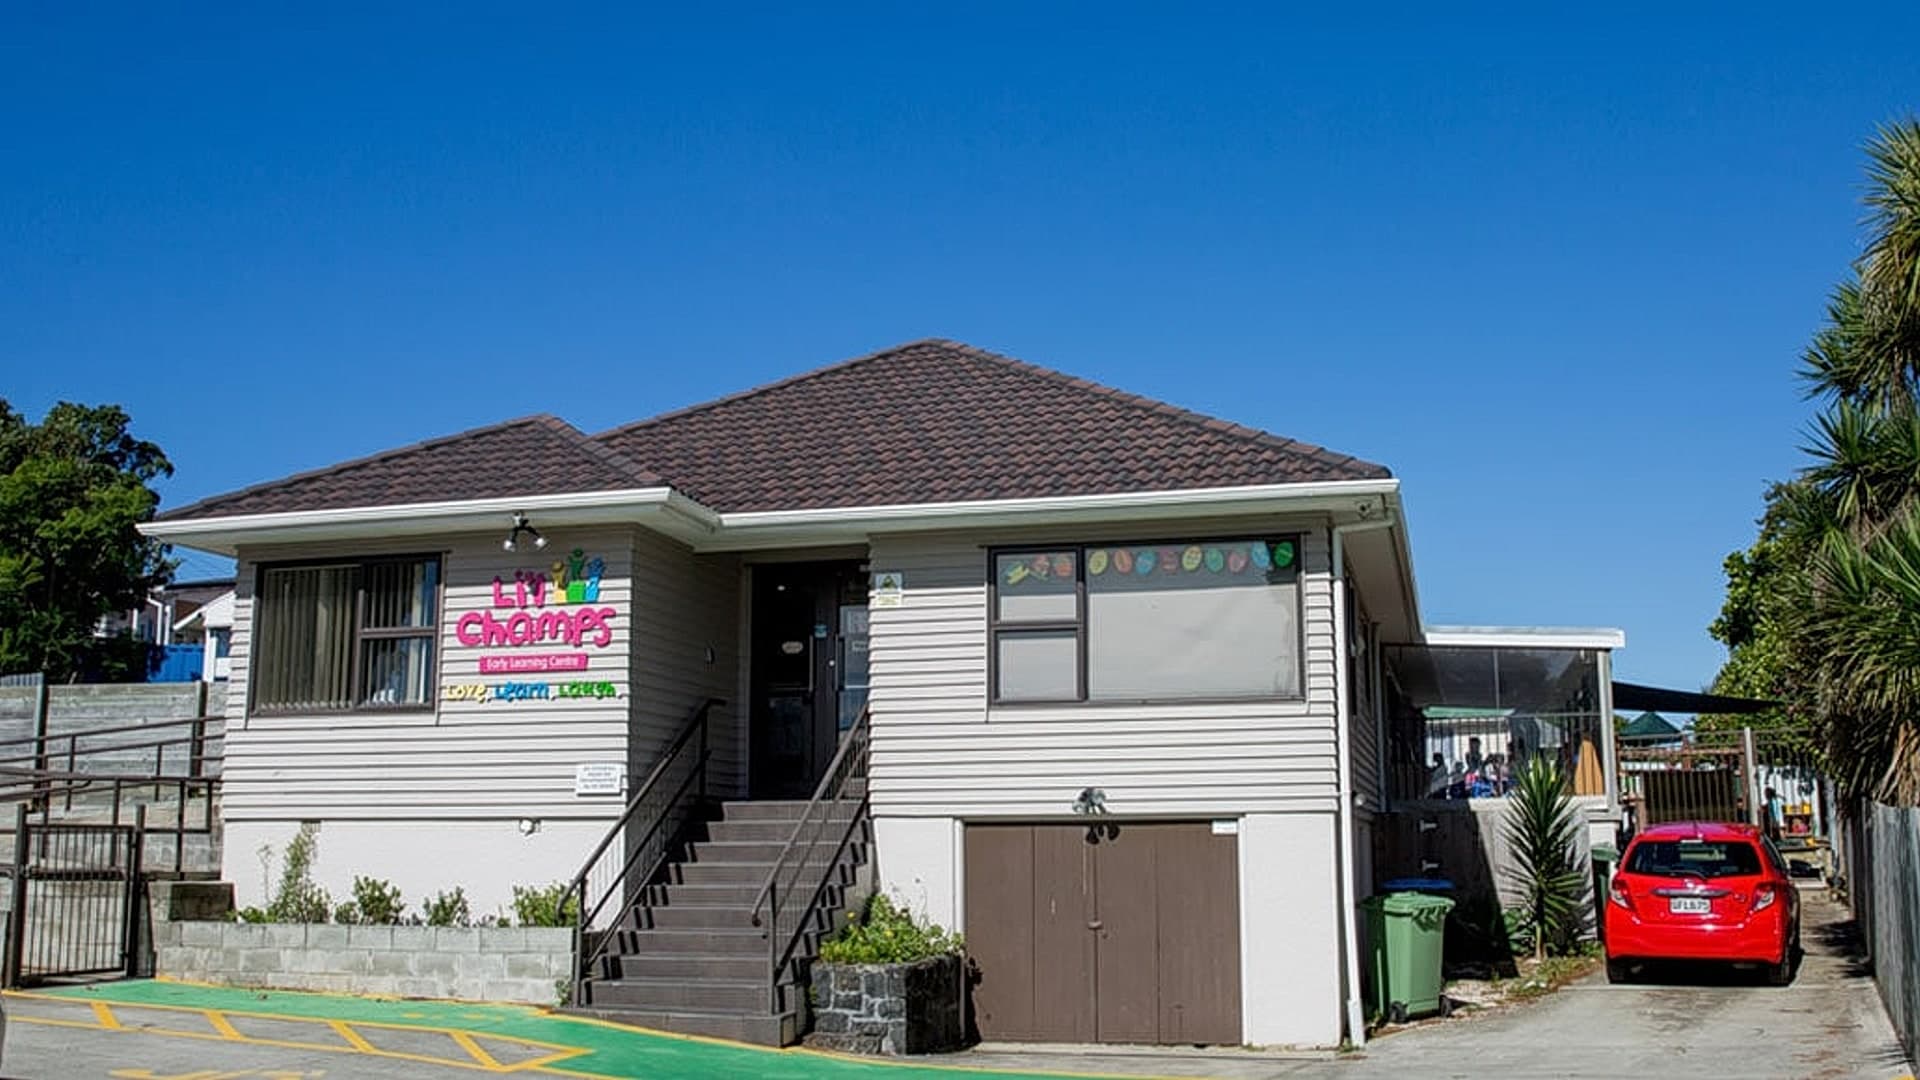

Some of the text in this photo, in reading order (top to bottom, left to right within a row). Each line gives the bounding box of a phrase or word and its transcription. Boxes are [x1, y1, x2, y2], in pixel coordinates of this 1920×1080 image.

[486, 655, 579, 672] Early Learning Centre
